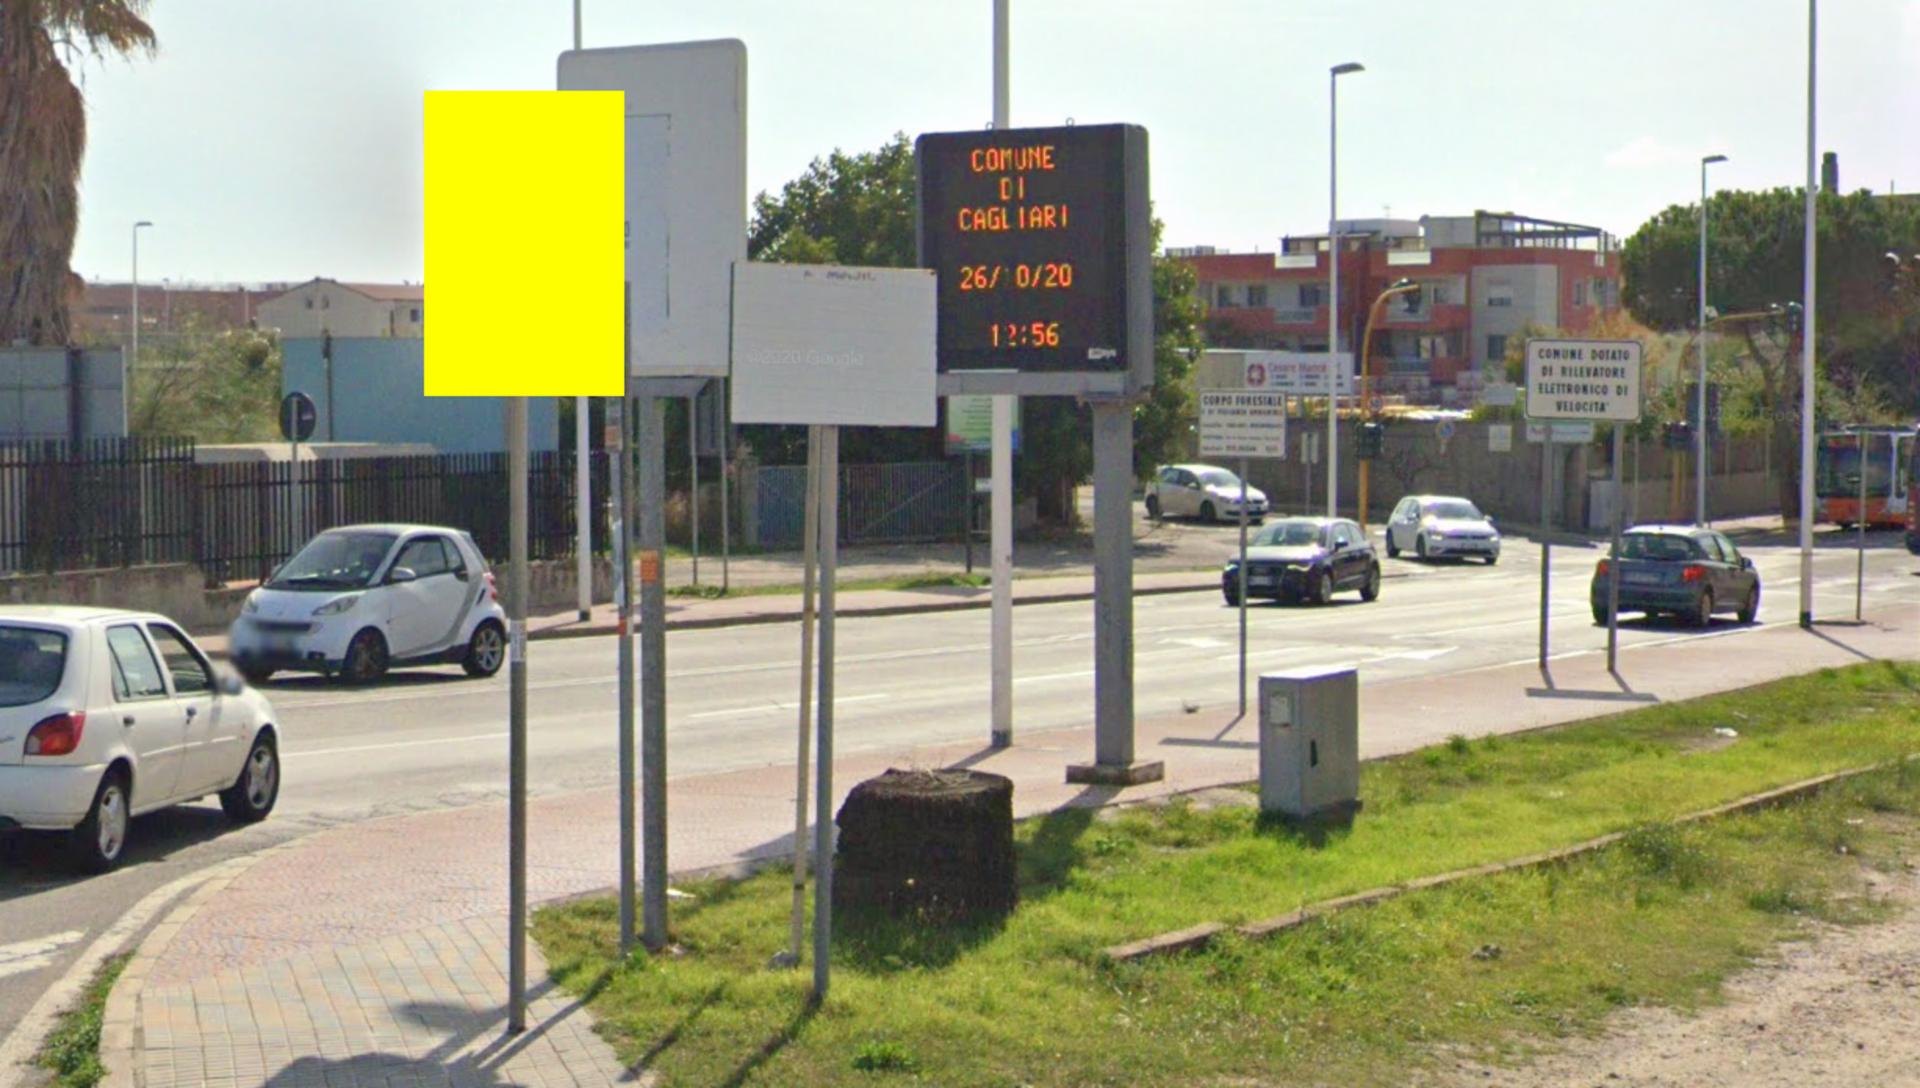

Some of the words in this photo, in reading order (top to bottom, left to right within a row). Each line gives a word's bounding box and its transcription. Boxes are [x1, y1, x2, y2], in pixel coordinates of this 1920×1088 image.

[970, 145, 1056, 172] COMUNE
[999, 176, 1025, 201] DI
[959, 204, 1068, 230] CAGLIARI
[960, 263, 1073, 289] 26/0/20
[991, 322, 1061, 347] 12:56
[1538, 348, 1584, 360] COMUNE
[1590, 348, 1630, 361] DOTATO
[1541, 365, 1554, 377] DI
[1561, 366, 1626, 378] RILEVATORE
[1203, 395, 1234, 407] CORPO
[1235, 395, 1282, 407] FORESTALE
[1538, 382, 1609, 395] ELETTRONICO
[1615, 385, 1629, 396] DI
